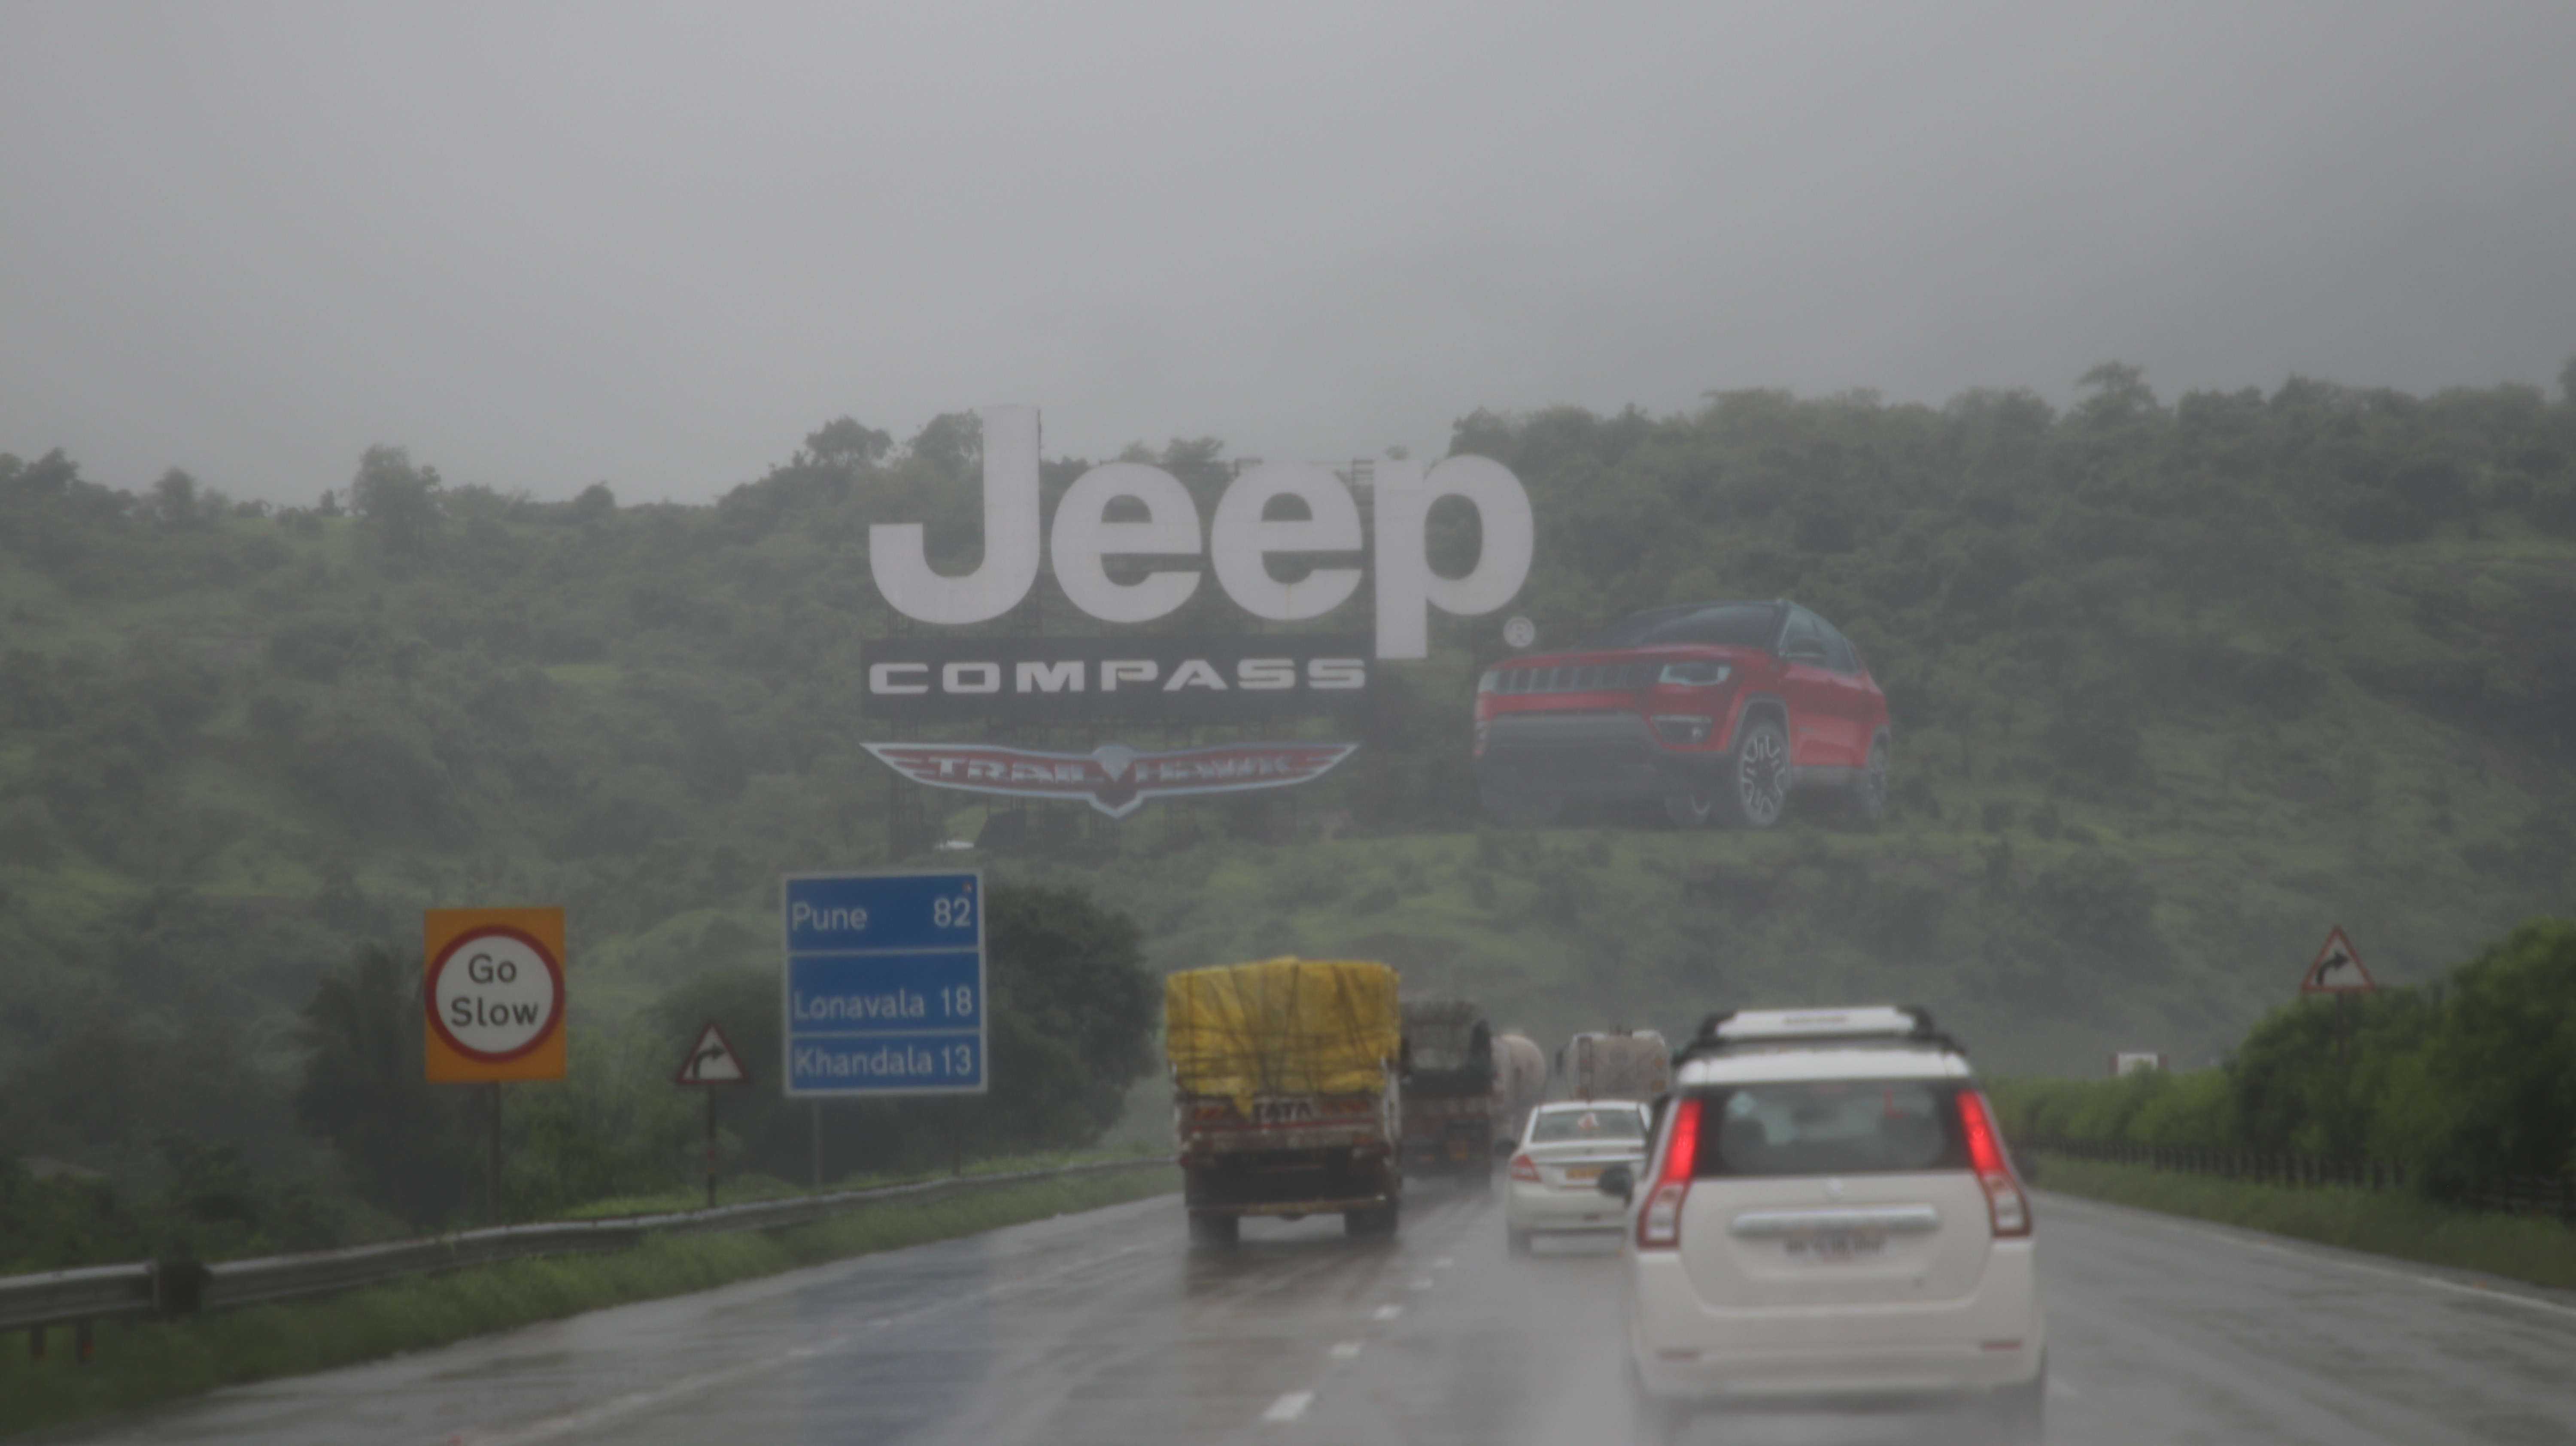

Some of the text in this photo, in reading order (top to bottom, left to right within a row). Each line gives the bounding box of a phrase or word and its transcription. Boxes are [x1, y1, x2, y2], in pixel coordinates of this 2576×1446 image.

[869, 406, 1534, 659] Jeep
[869, 659, 1366, 695] COMPASS
[792, 896, 971, 931] Pune 82
[468, 952, 517, 984] Go
[451, 996, 539, 1027] Slow
[793, 984, 973, 1021] Lonavala 18
[794, 1043, 972, 1078] Khandala 13
